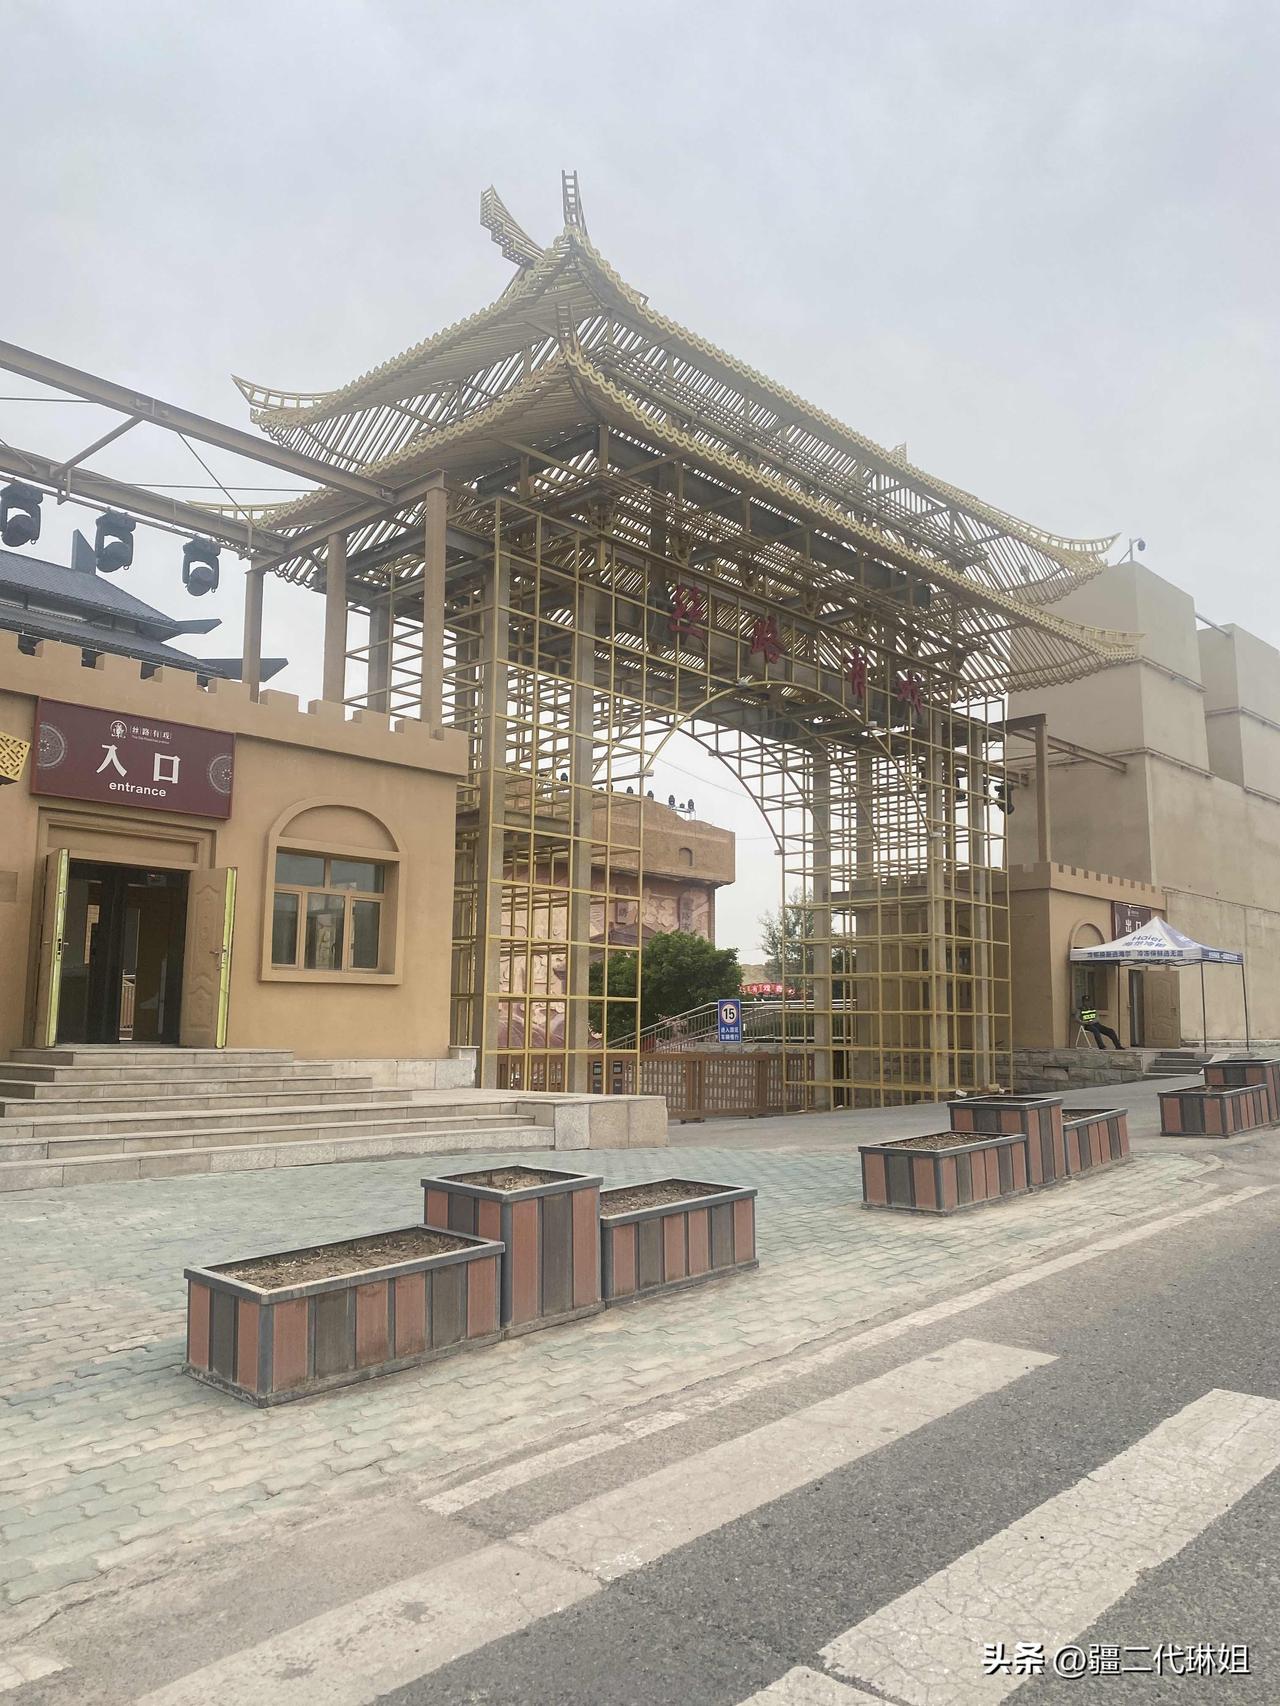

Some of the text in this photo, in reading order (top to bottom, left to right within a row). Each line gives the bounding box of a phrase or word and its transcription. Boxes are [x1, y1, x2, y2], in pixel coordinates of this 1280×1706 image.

[96, 744, 181, 784] 入口
[109, 781, 167, 797] entrance
[1125, 919, 1142, 933] 出口
[723, 1008, 735, 1020] 15
